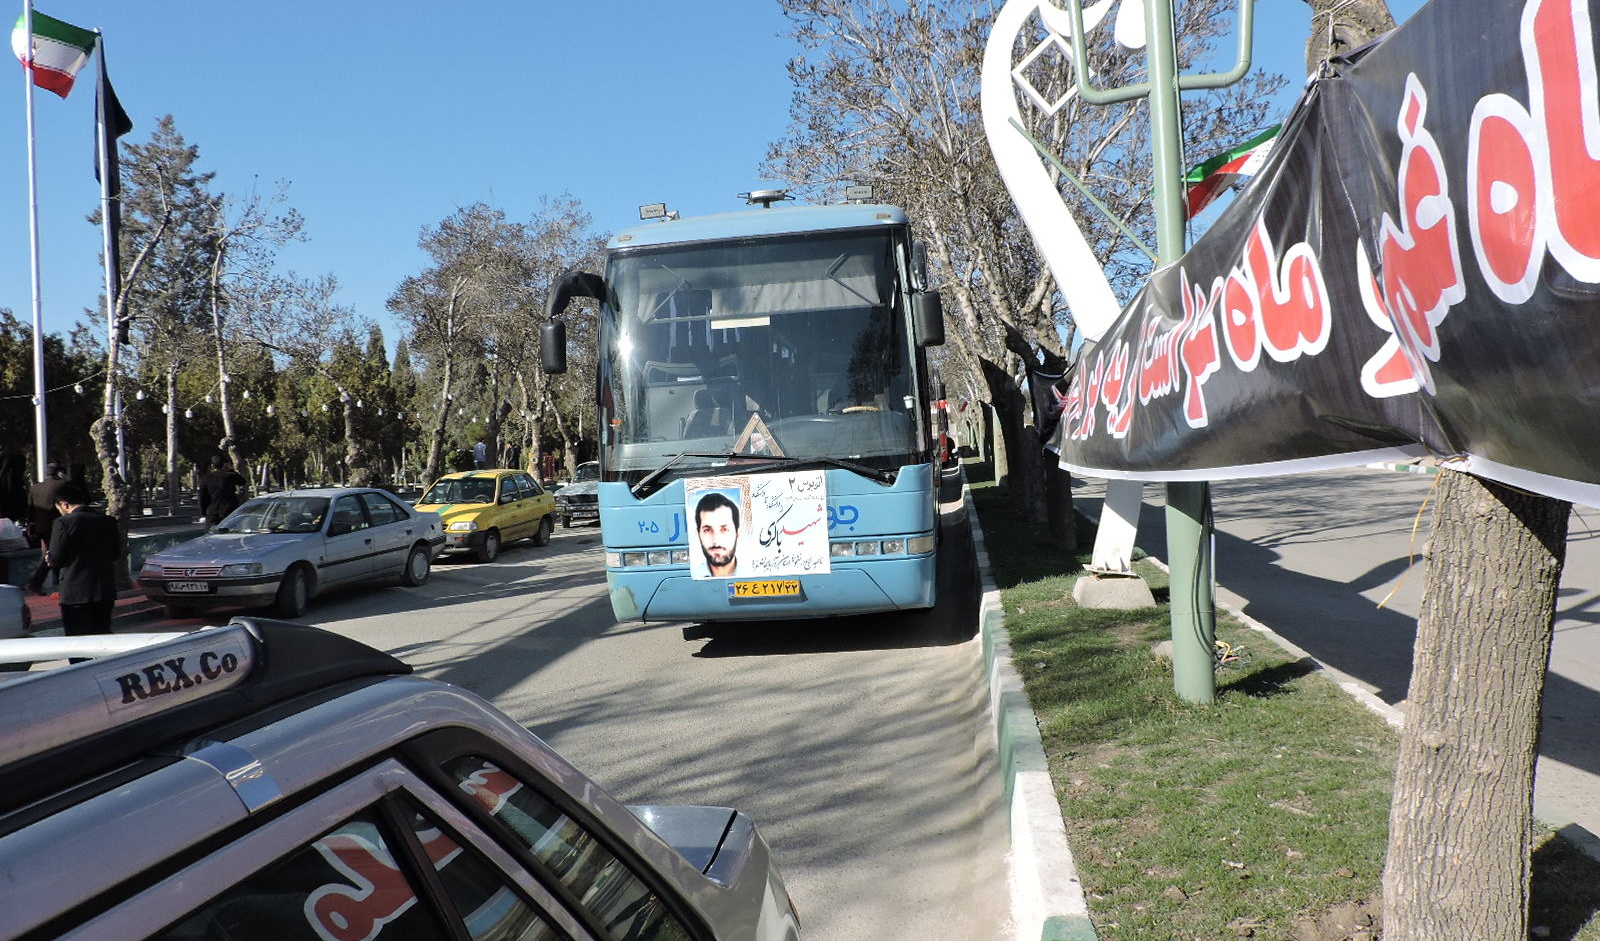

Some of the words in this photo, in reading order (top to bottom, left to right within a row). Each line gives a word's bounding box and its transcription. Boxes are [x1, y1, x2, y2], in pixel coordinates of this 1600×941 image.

[1220, 212, 1332, 373] ماه
[638, 520, 659, 534] ۲۰۵
[759, 504, 793, 553] باکری
[780, 504, 823, 546] شهید
[114, 650, 239, 705] REX.Co
